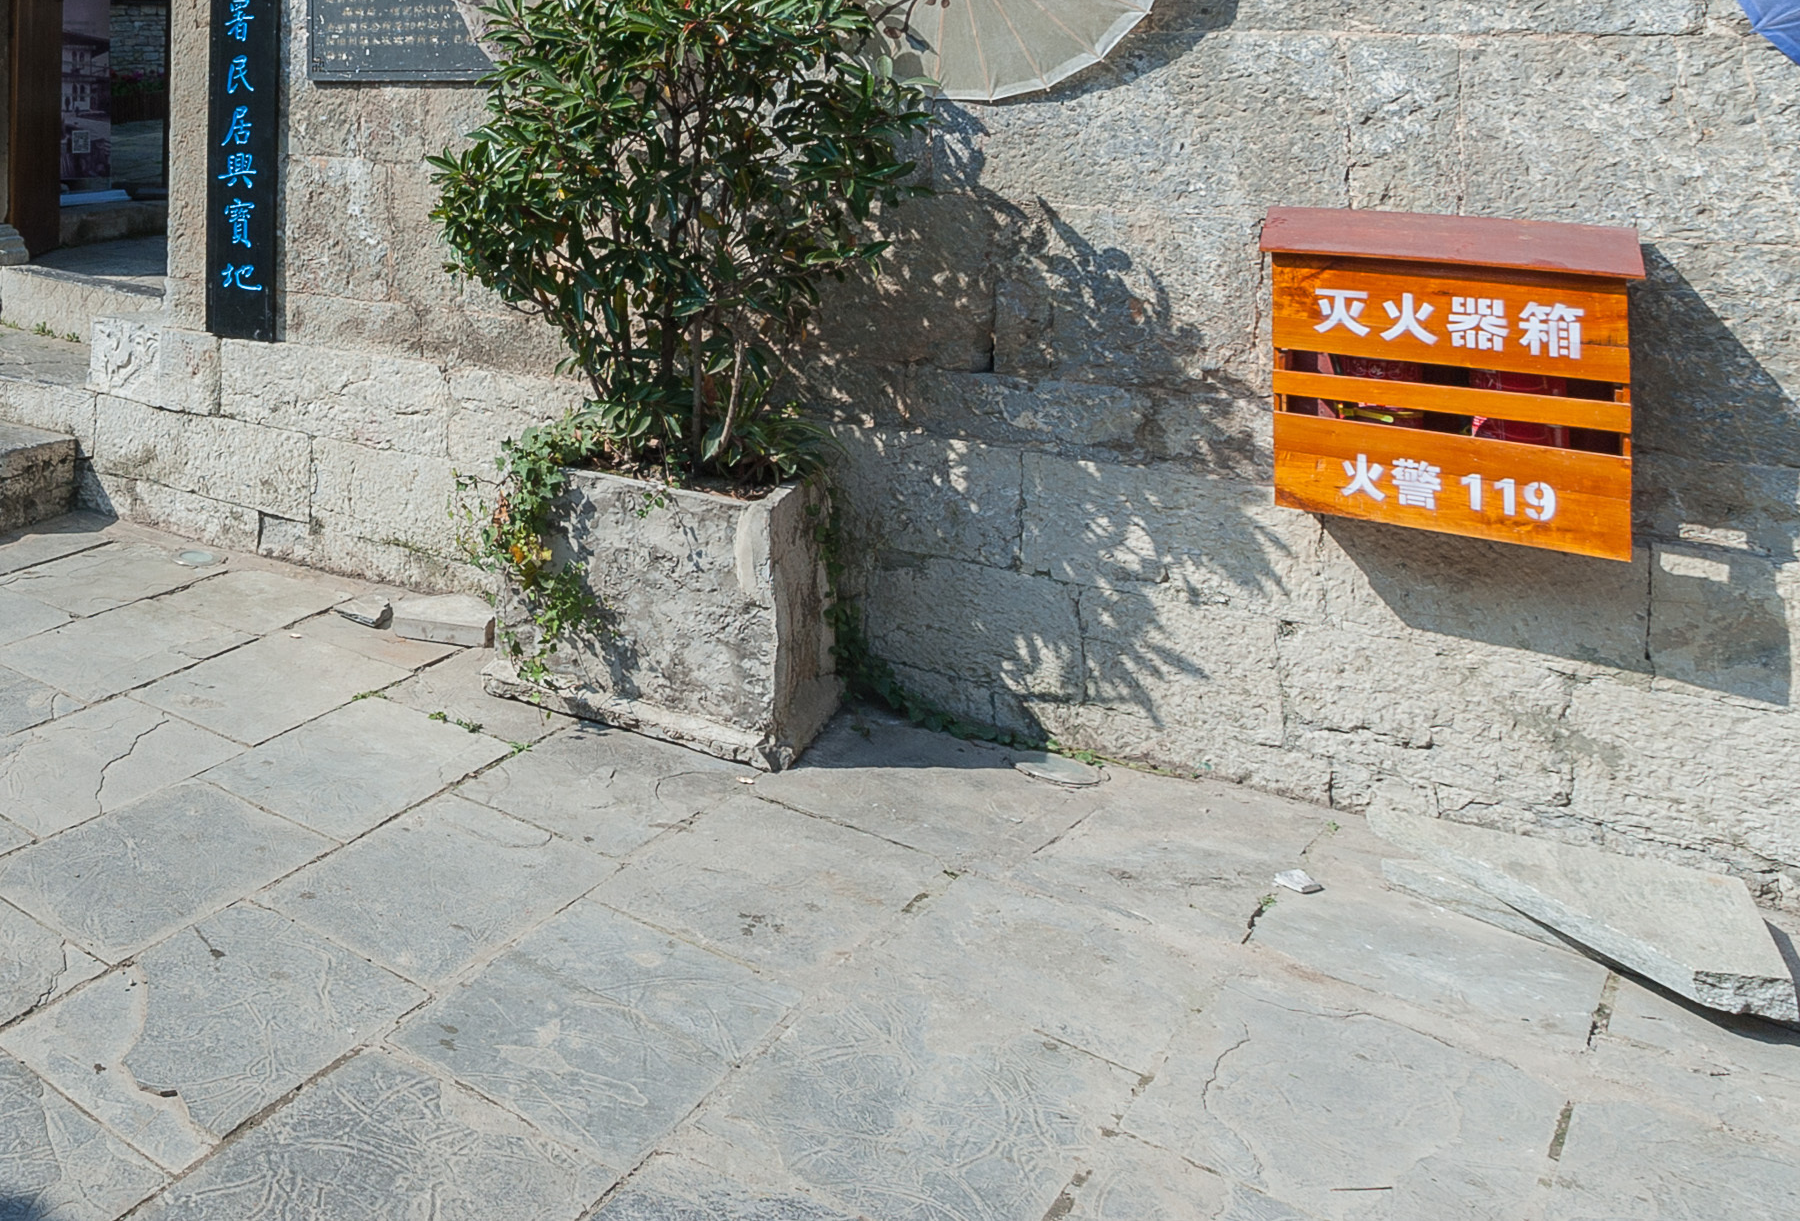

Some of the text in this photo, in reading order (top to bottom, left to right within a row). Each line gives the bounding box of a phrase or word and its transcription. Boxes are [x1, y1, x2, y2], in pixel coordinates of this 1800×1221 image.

[1312, 287, 1585, 360] 灭火器箱
[1341, 453, 1557, 521] 火警 119
